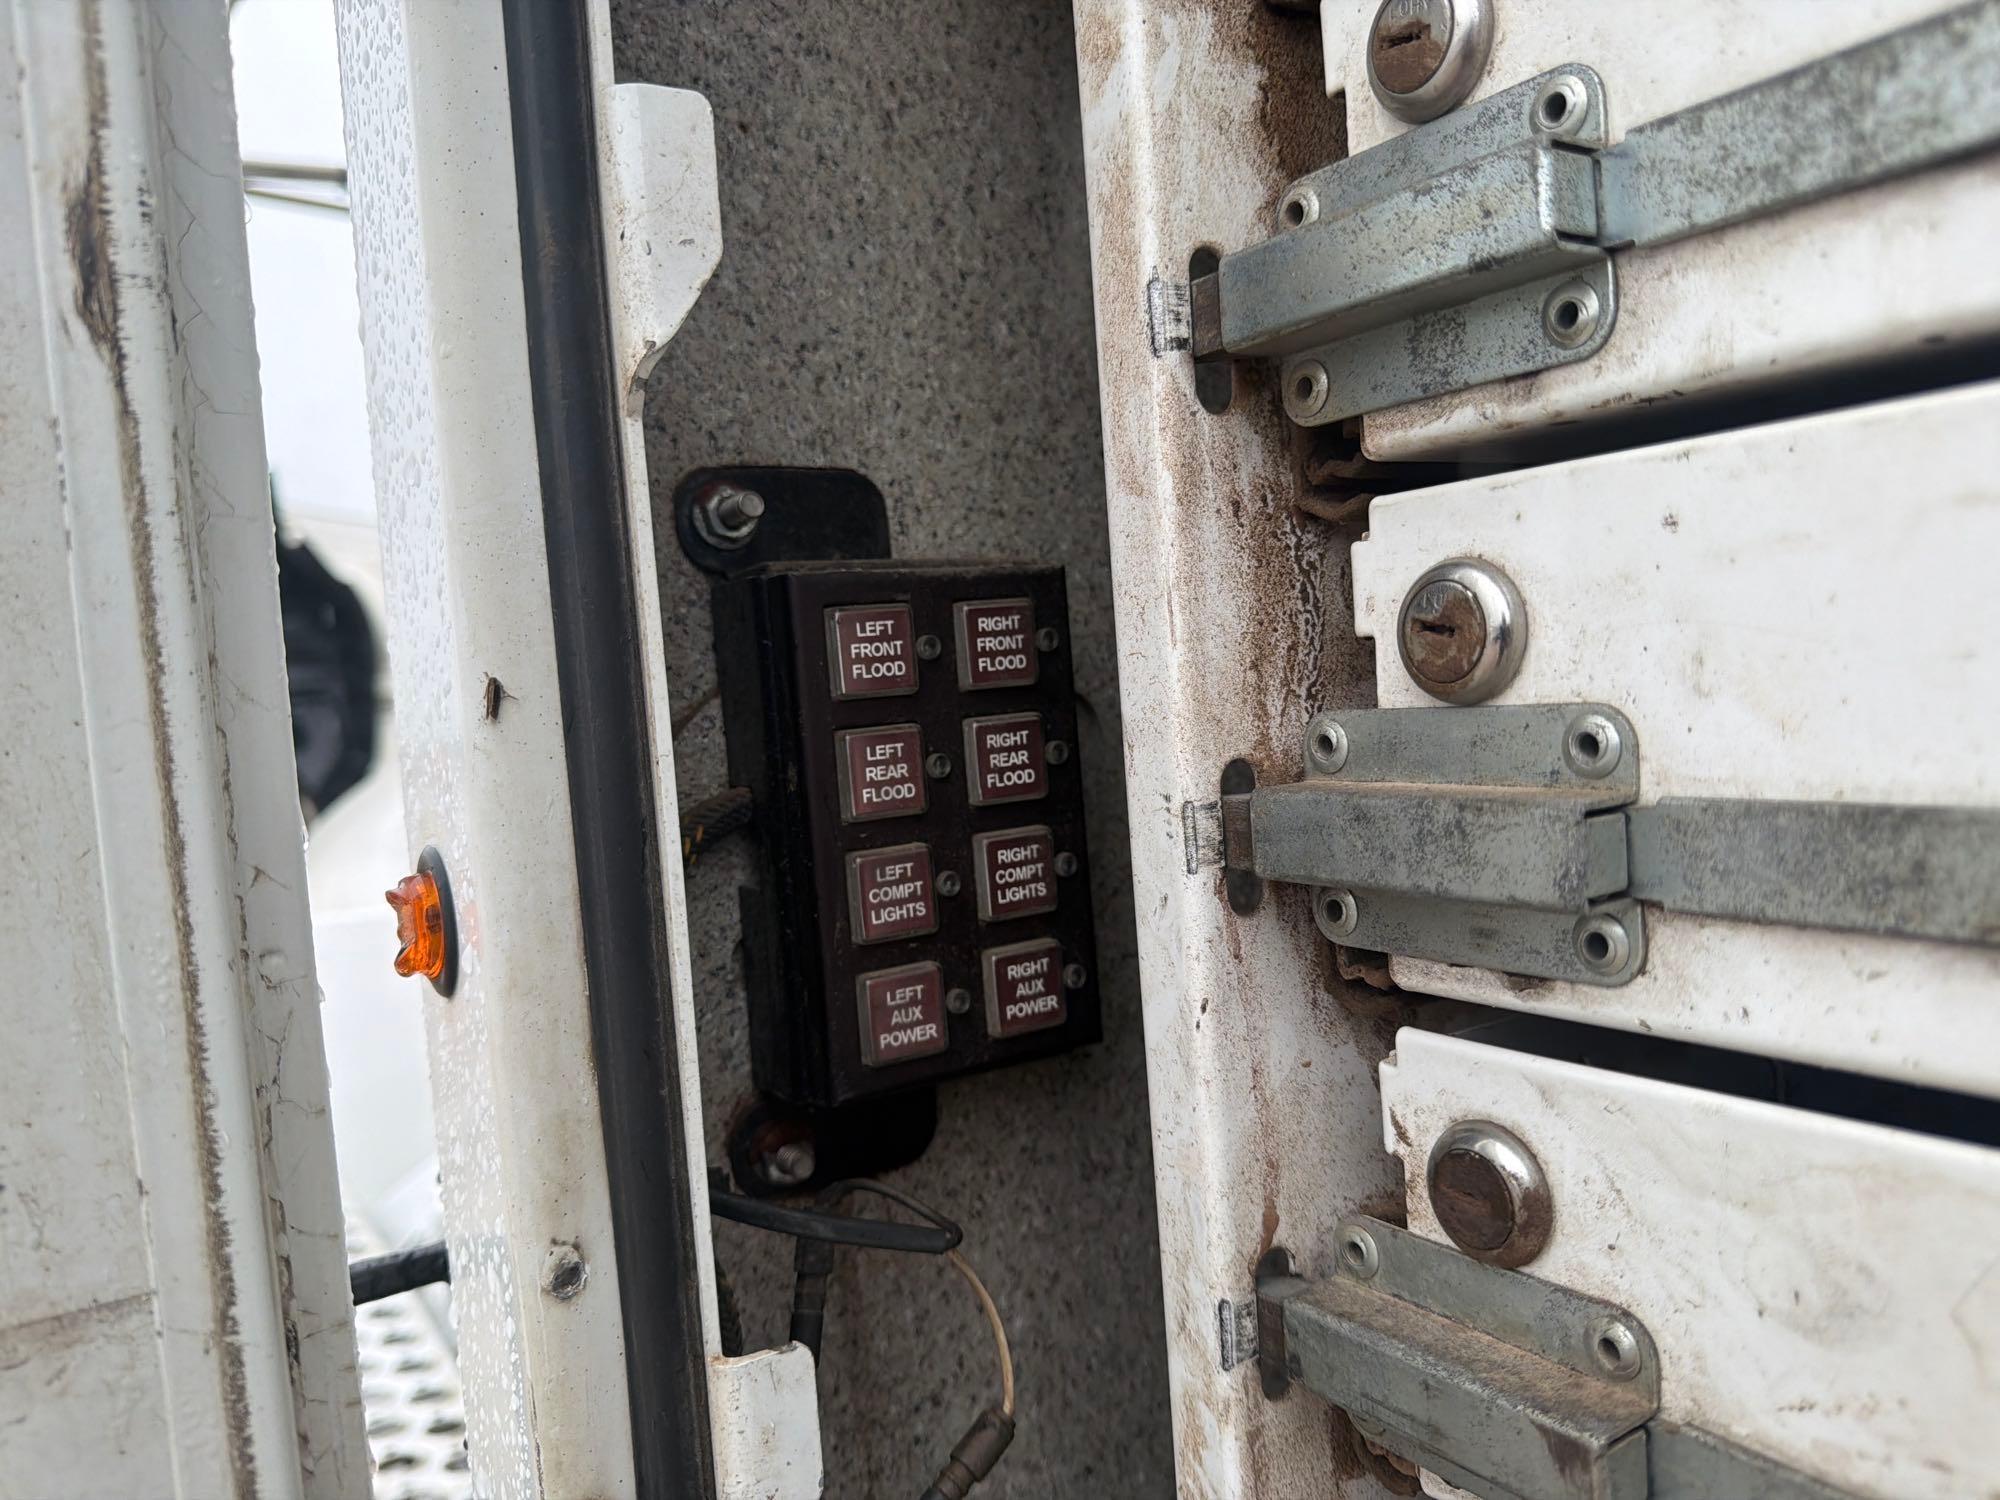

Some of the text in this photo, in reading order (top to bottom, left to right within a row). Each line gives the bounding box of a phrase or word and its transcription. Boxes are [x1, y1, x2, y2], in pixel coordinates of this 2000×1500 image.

[856, 620, 894, 637] LEFT
[978, 615, 1020, 632] RIGHT
[851, 641, 903, 658] FRONT
[977, 635, 1024, 651] FRONT
[853, 661, 905, 679] FLOOD
[978, 655, 1026, 672] FLOOD
[986, 731, 1029, 748] RIGHT
[867, 743, 904, 761] LEFT
[990, 750, 1029, 768] REAR
[866, 763, 908, 782] REAR
[987, 769, 1035, 788] FLOOD
[862, 783, 915, 803] FLOOD
[997, 844, 1040, 864] RIGHT
[876, 863, 914, 882] LEFT
[996, 863, 1044, 884] COMPT
[869, 881, 923, 903] COMPT
[997, 883, 1046, 904] LIGHTS
[871, 902, 926, 924] LIGHTS
[1007, 958, 1049, 979] RIGHT
[887, 985, 924, 1005] LEFT
[1016, 979, 1044, 997] AUX
[891, 1006, 923, 1026] AUX
[1006, 996, 1058, 1019] POWER
[880, 1024, 937, 1048] POWER
